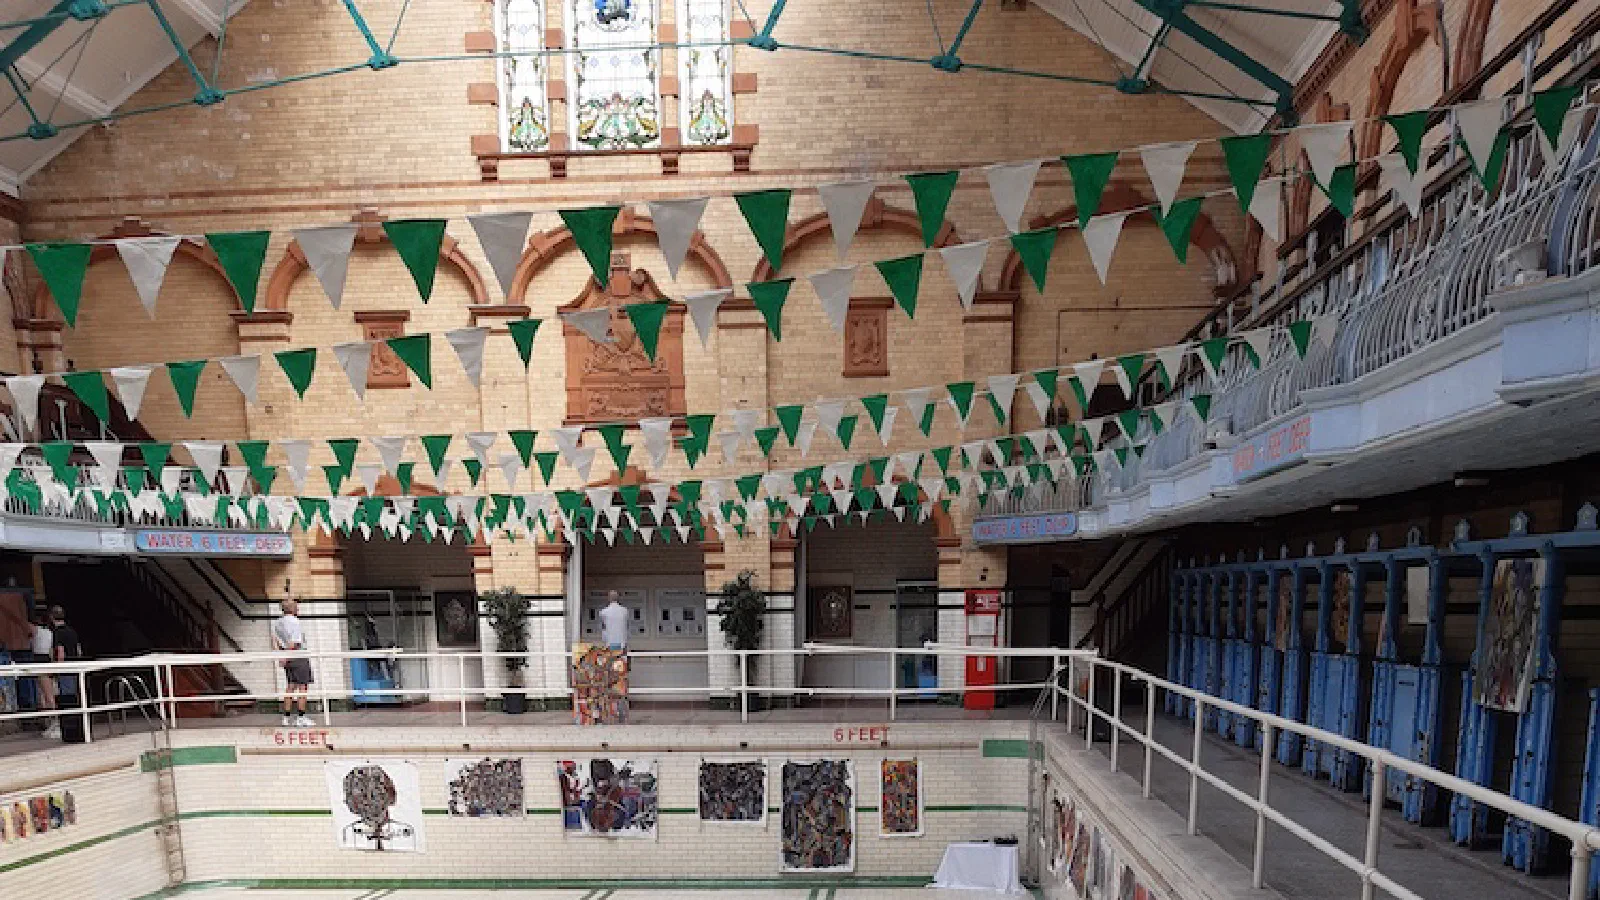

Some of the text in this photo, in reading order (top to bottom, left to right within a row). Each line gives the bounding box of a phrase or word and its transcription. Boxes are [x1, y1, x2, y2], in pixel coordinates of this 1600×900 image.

[145, 533, 288, 550] WATER 6 FEET DEEP
[274, 730, 329, 746] 6 FEET
[834, 726, 890, 743] 6 FEET
